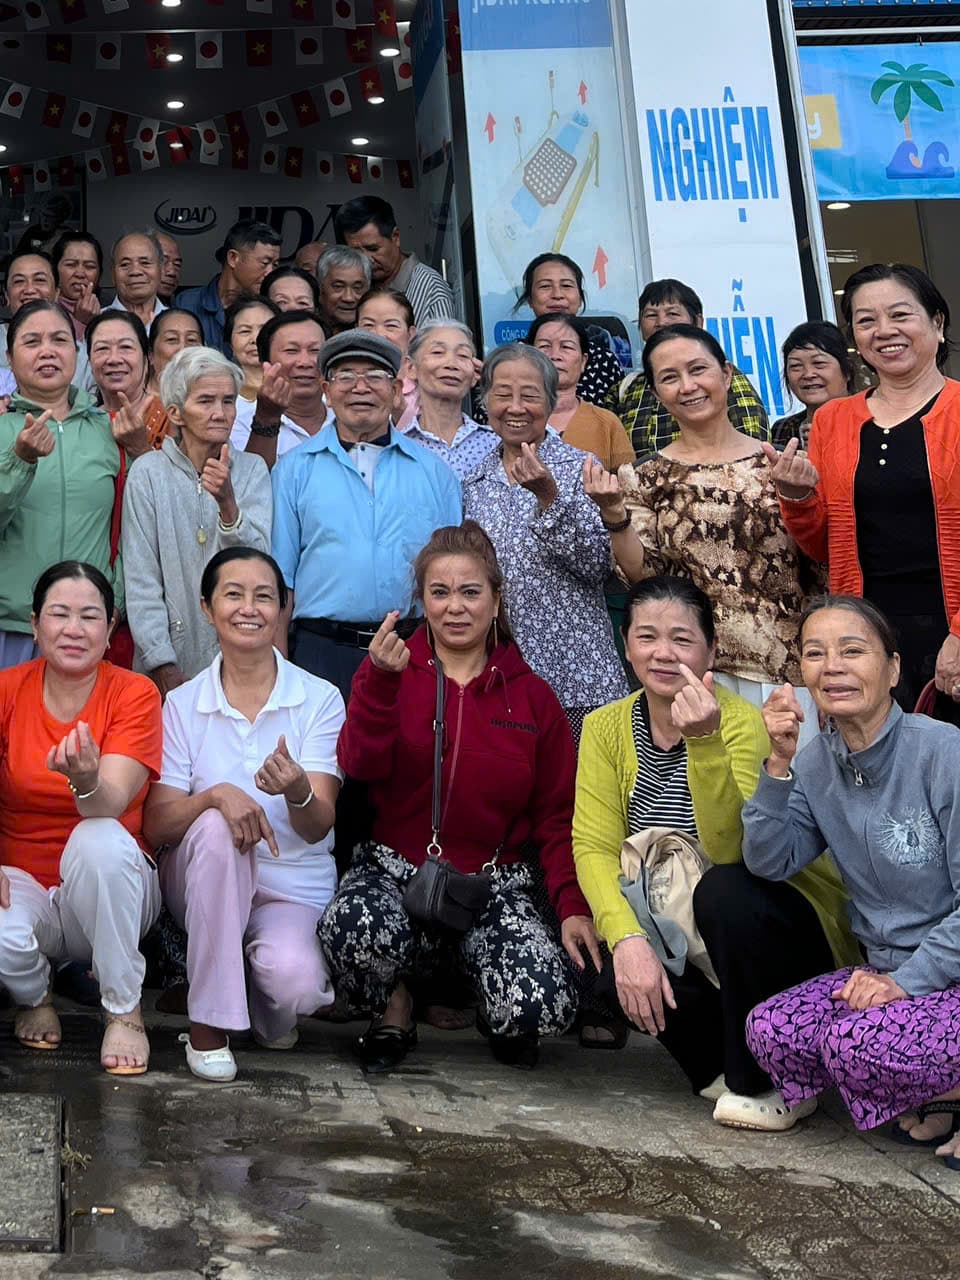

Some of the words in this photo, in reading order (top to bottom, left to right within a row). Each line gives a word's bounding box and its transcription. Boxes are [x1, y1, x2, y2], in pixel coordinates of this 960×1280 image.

[165, 207, 208, 223] JIDAI
[645, 86, 779, 223] NGHIỆM
[706, 278, 785, 416] IỄN
